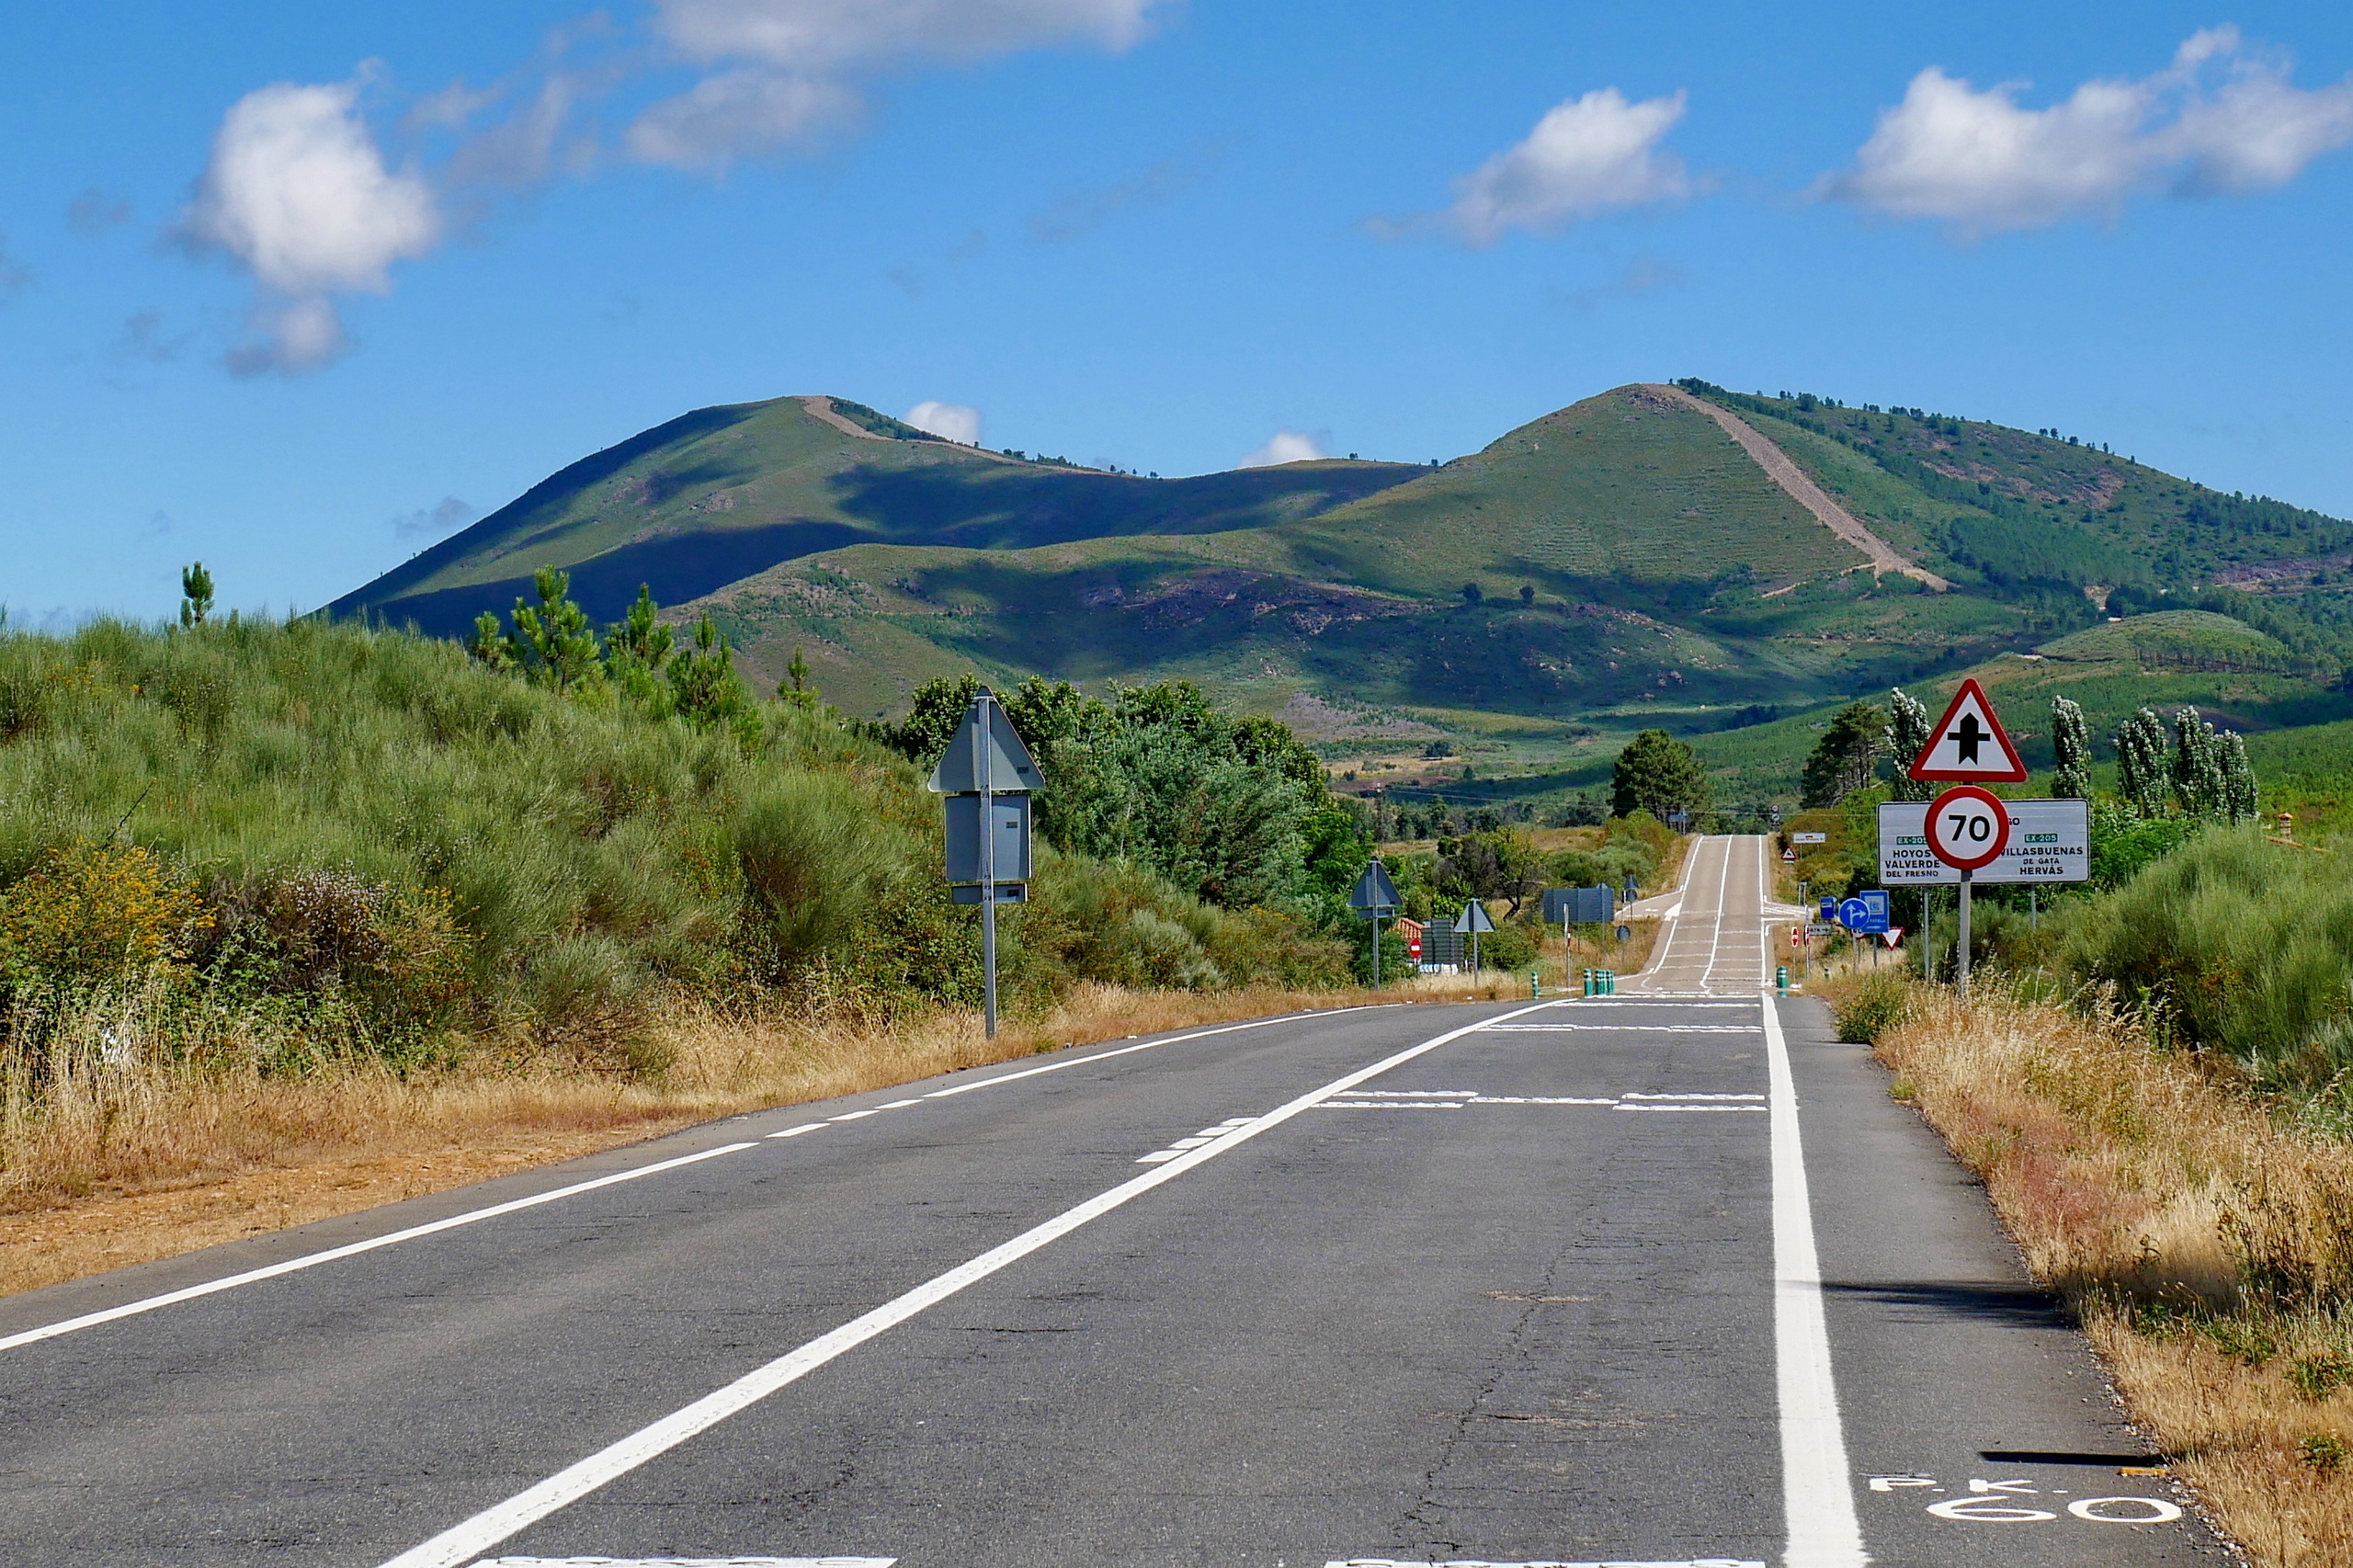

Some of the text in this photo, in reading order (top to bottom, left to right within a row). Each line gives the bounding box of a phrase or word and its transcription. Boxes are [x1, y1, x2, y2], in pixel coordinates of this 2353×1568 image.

[1949, 814, 1990, 842] 70
[1893, 849, 1931, 858] HOYOS
[2001, 846, 2083, 856] VILLASBUENAS
[1884, 859, 1940, 869] VALVERDE
[2019, 865, 2063, 875] HERVÁS
[1927, 1496, 2182, 1522] 60
